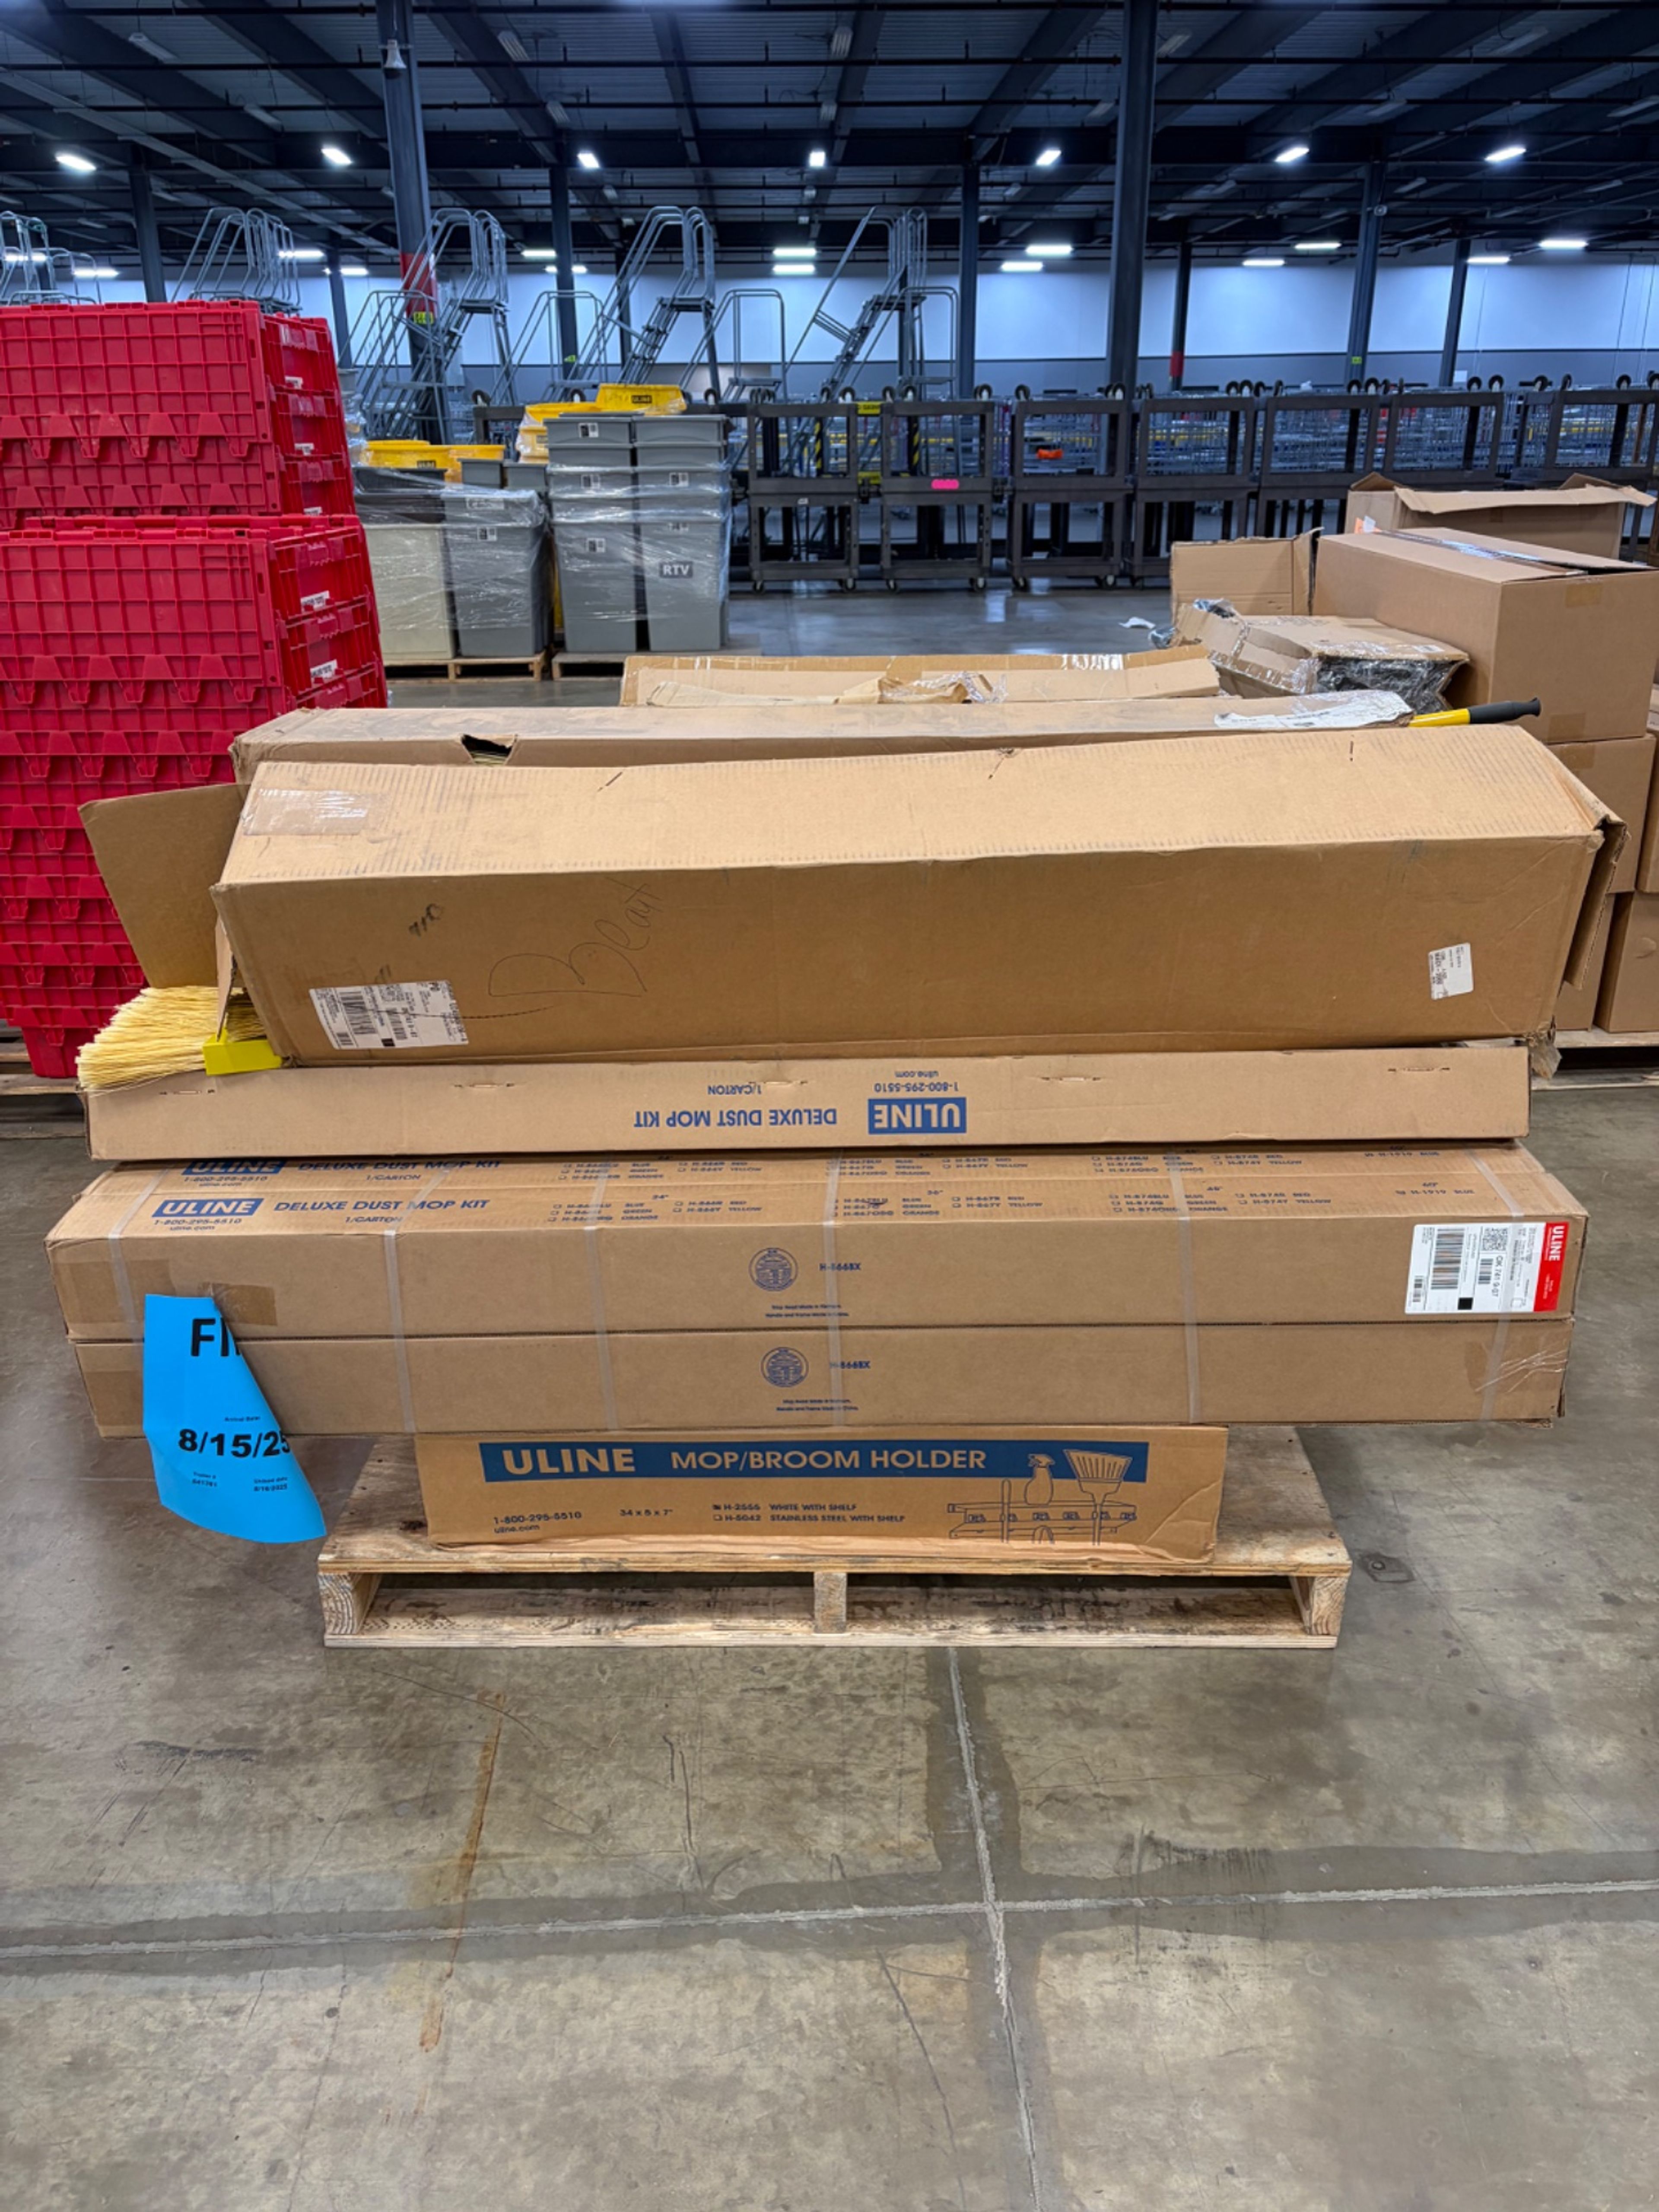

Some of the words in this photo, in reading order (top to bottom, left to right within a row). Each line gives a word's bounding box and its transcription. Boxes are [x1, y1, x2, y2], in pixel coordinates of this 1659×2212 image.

[663, 564, 689, 575] RTV
[707, 1084, 762, 1095] 1/CARTON
[874, 1082, 959, 1092] 1-800-295-5510
[634, 1111, 660, 1128] KIT
[666, 1110, 711, 1127] MOP
[717, 1109, 762, 1126] DUST
[769, 1109, 837, 1126] DELUXE
[874, 1103, 960, 1128] ULINE
[191, 1161, 282, 1173] ULINE
[298, 1162, 369, 1171] DELUXE
[373, 1161, 419, 1170] DUST
[162, 1201, 256, 1214] ULINE
[274, 1201, 347, 1211] DELUXE
[353, 1201, 403, 1210] DUST
[407, 1200, 456, 1210] MOP
[460, 1199, 491, 1208] KIT
[1548, 1226, 1565, 1262] ULINE
[191, 1318, 240, 1357] FI
[502, 1449, 635, 1475] ULINE
[671, 1450, 859, 1471] MOP/BROOM
[871, 1449, 986, 1468] HOLDER
[494, 1512, 582, 1525] 1-800-295-5510
[495, 1524, 540, 1534] uline.com
